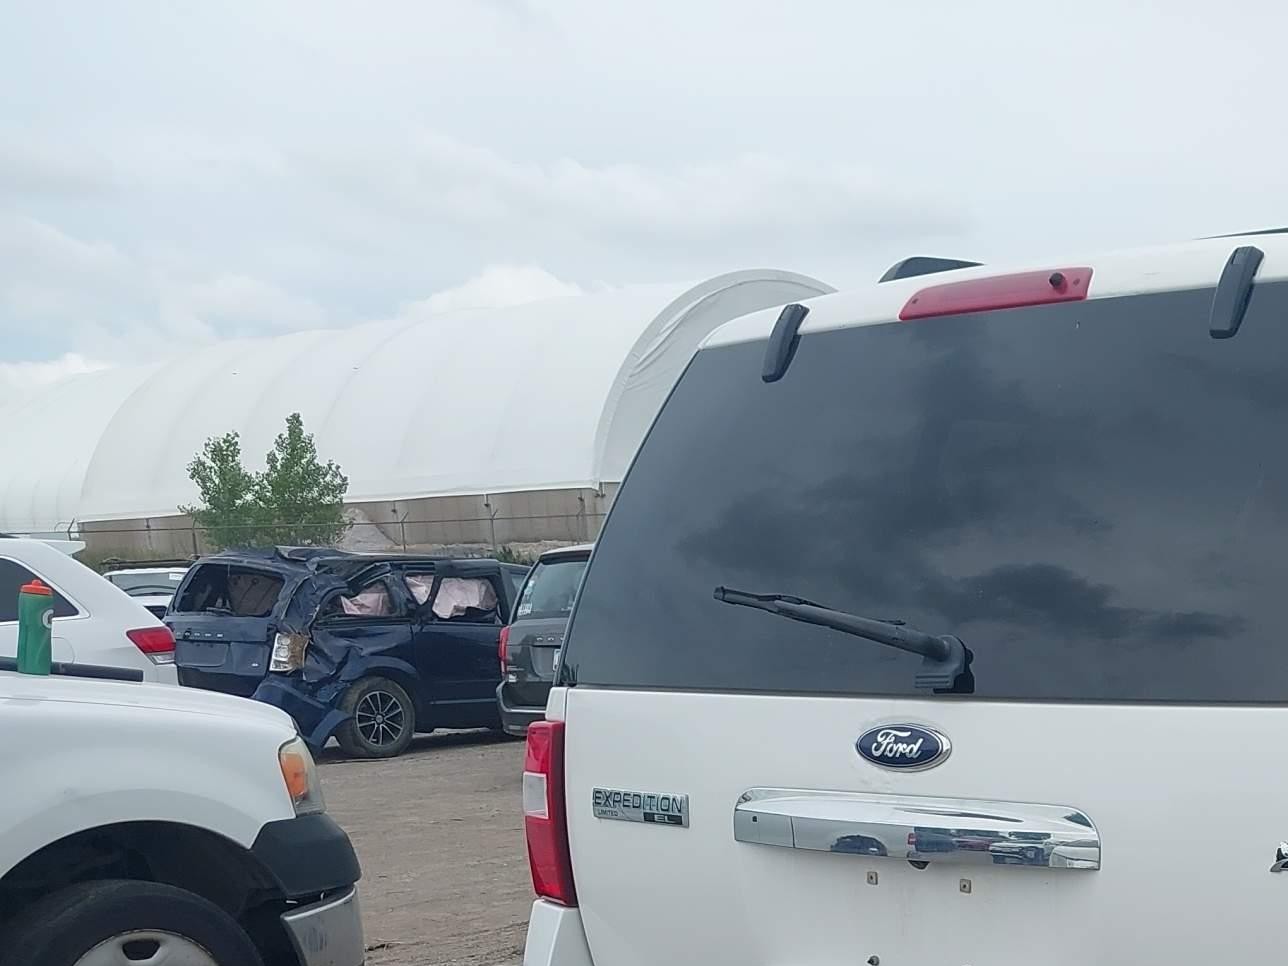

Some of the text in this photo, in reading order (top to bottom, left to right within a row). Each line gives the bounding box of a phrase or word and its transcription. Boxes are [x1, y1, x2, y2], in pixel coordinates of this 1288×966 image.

[871, 729, 924, 758] Ford
[594, 790, 682, 813] EXPEDITION
[597, 808, 619, 817] LIMITED
[654, 814, 671, 823] EL
